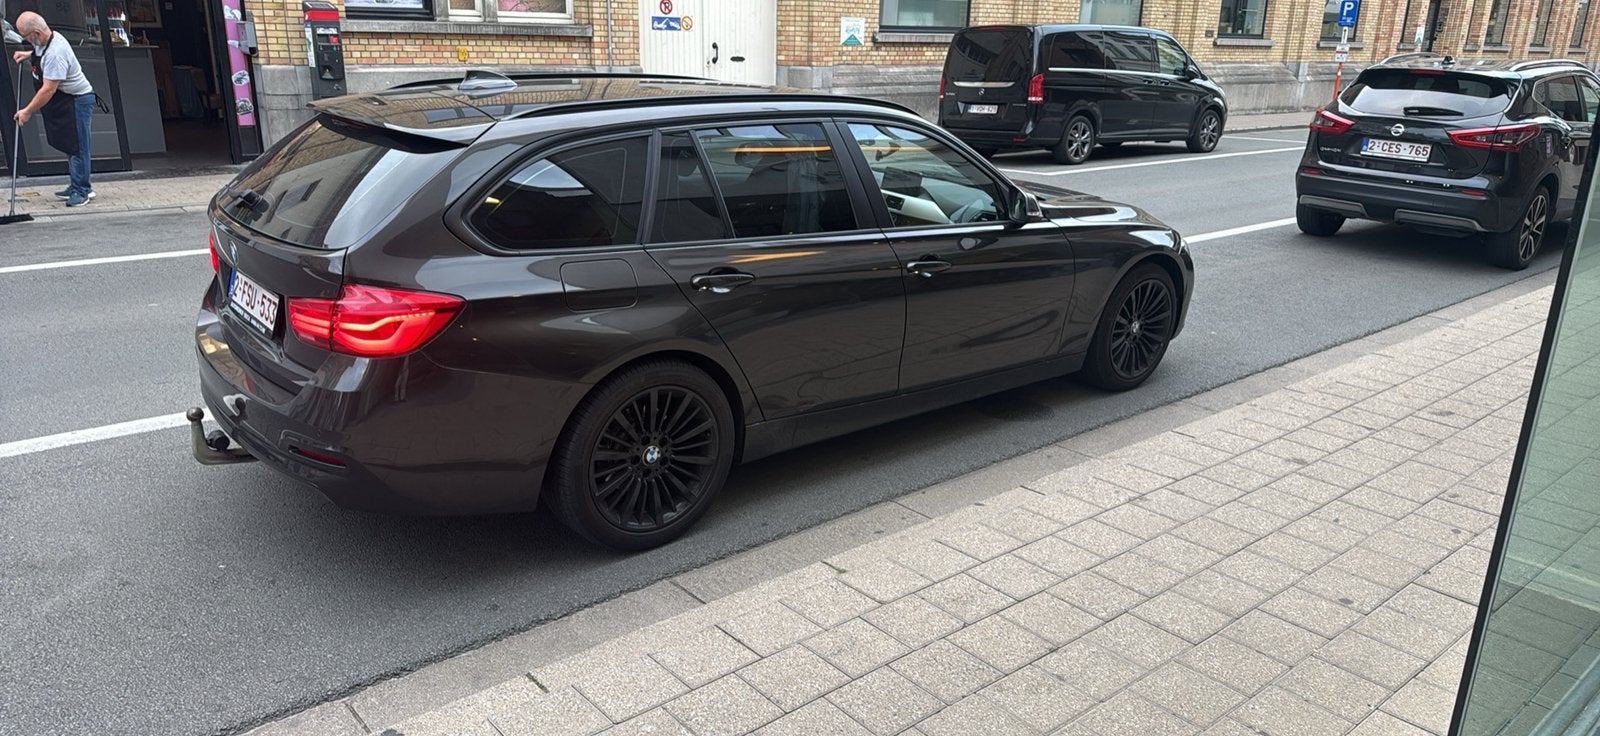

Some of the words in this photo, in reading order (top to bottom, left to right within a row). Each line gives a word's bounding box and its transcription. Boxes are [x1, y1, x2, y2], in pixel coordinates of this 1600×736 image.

[1343, 2, 1354, 16] P
[1369, 141, 1429, 156] 2-CES-765
[233, 275, 278, 325] 2-FSU-533
